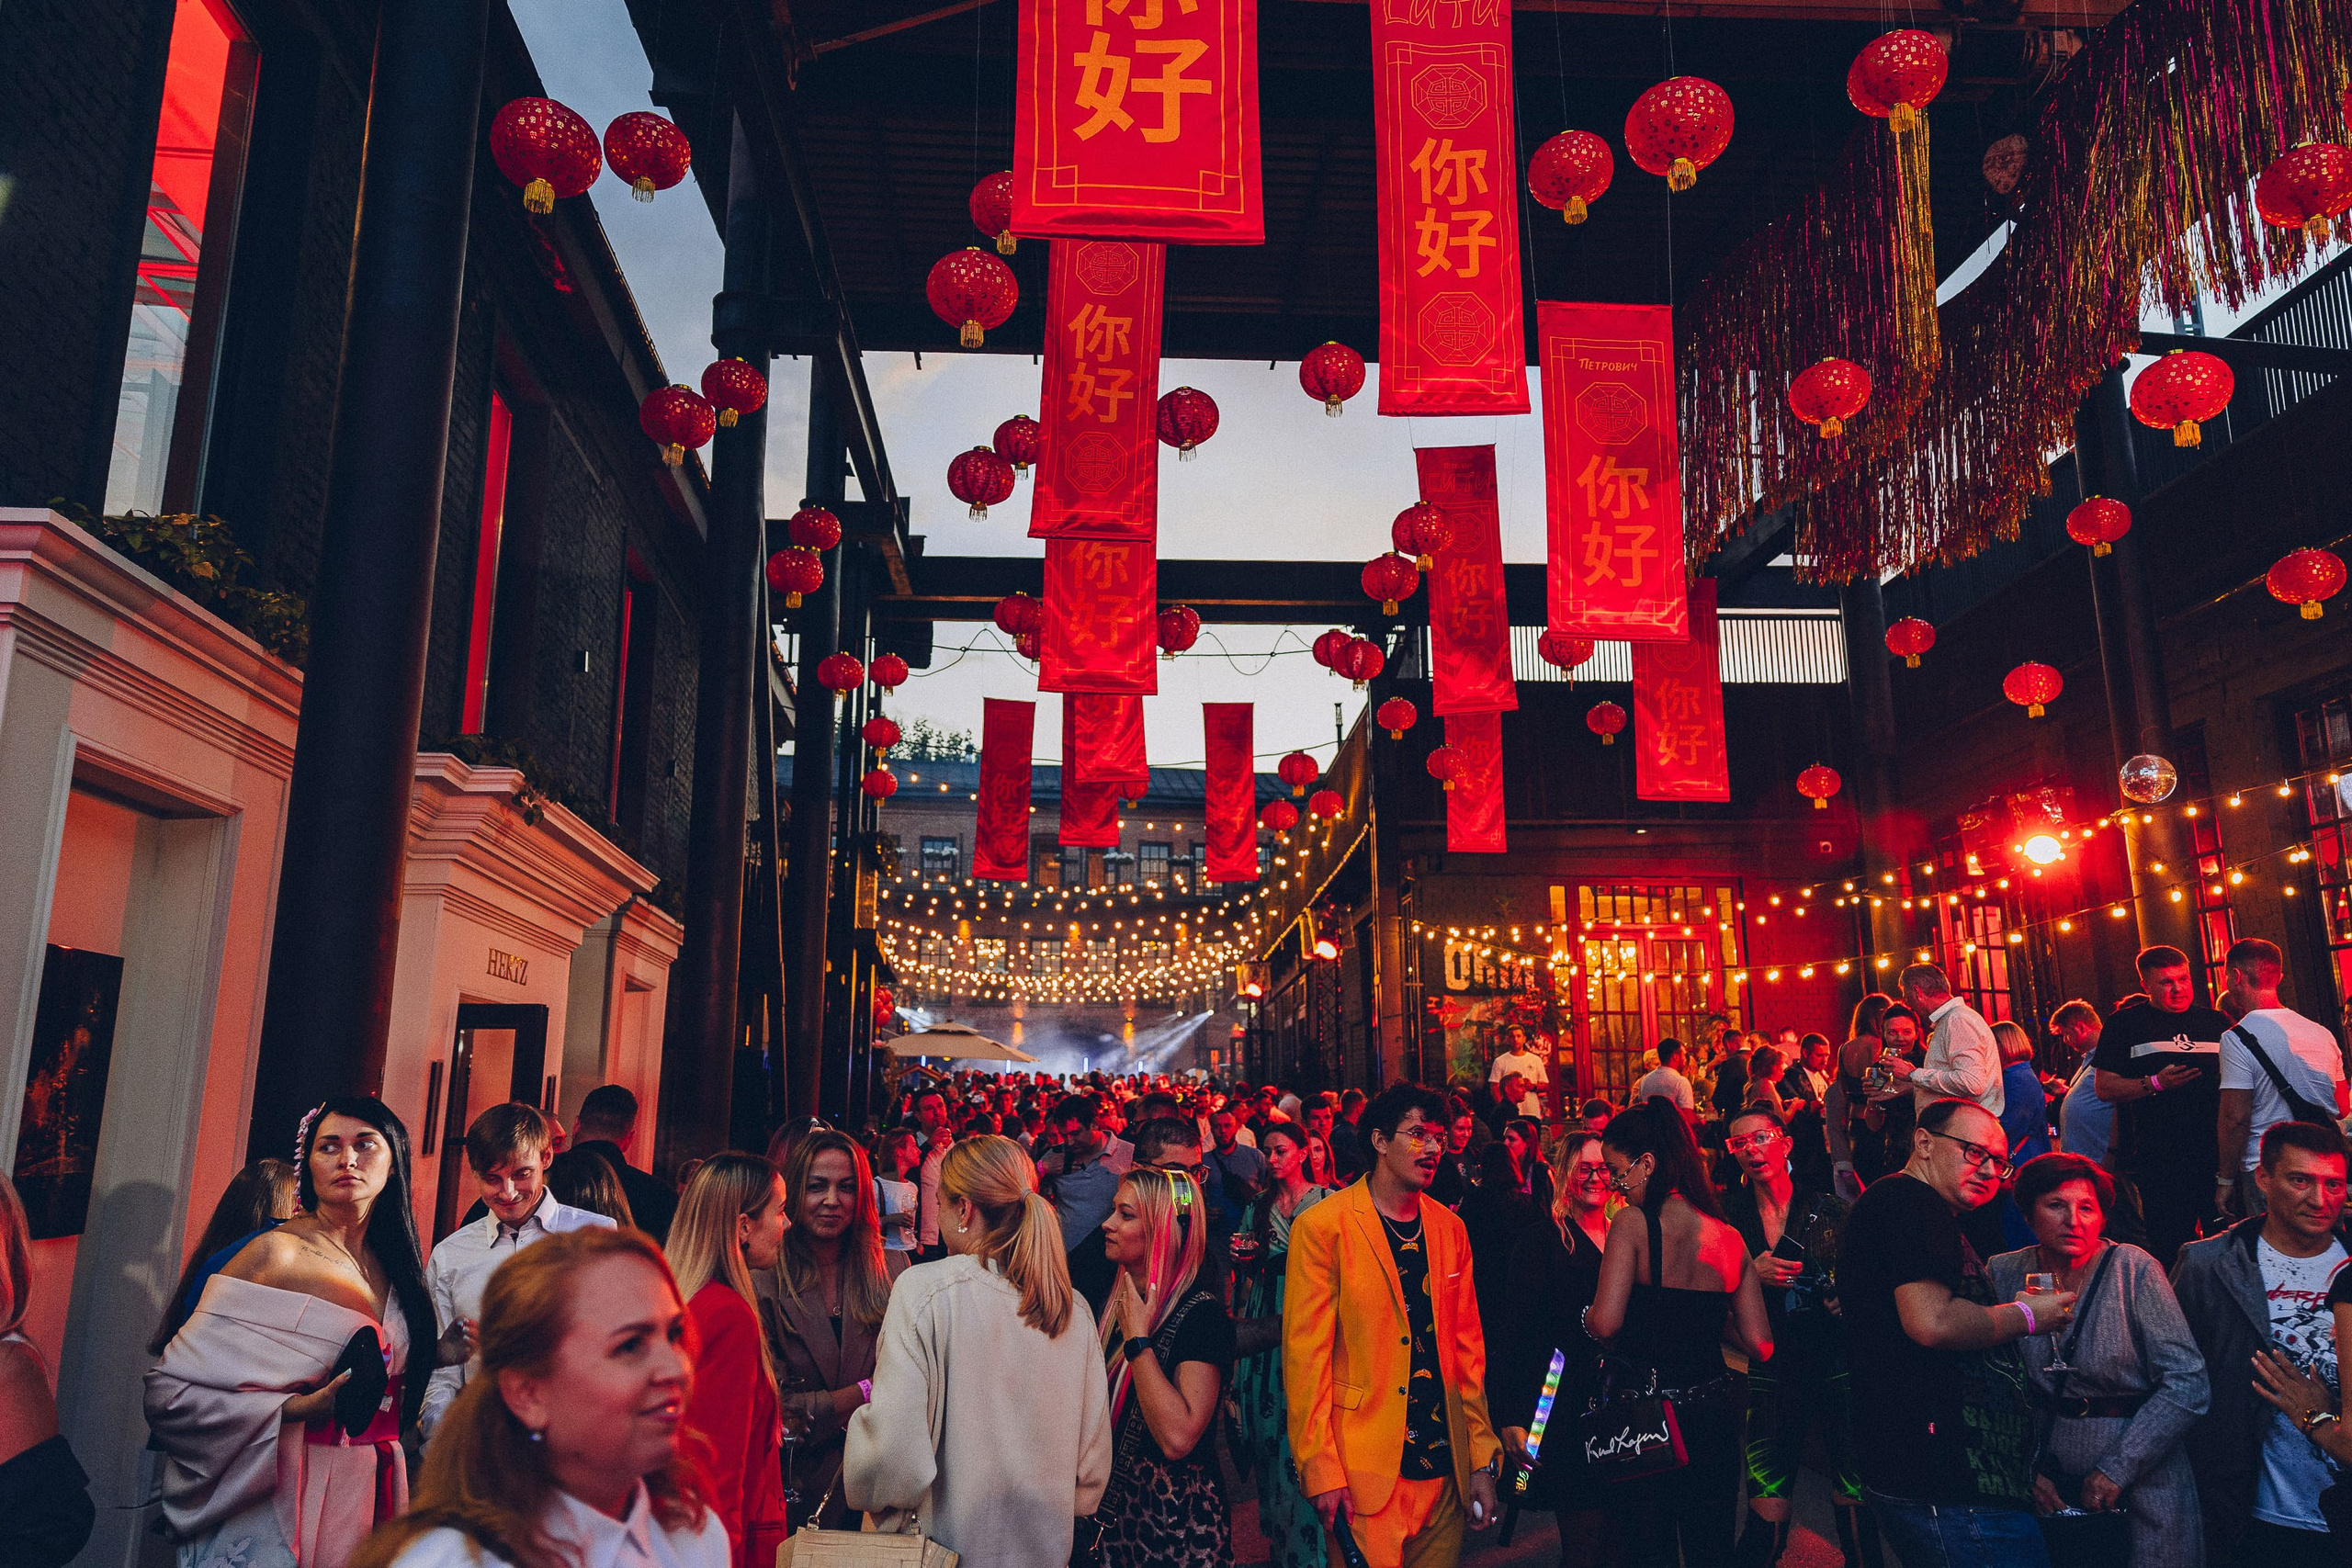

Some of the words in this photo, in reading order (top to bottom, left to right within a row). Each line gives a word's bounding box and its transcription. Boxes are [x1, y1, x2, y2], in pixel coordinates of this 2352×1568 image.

[1409, 137, 1497, 278] 你好
[1067, 302, 1134, 423] 你好
[1576, 455, 1659, 587] 你好
[1066, 540, 1134, 649] 你好
[1444, 558, 1494, 640] 你好
[1654, 677, 1708, 766] 你好
